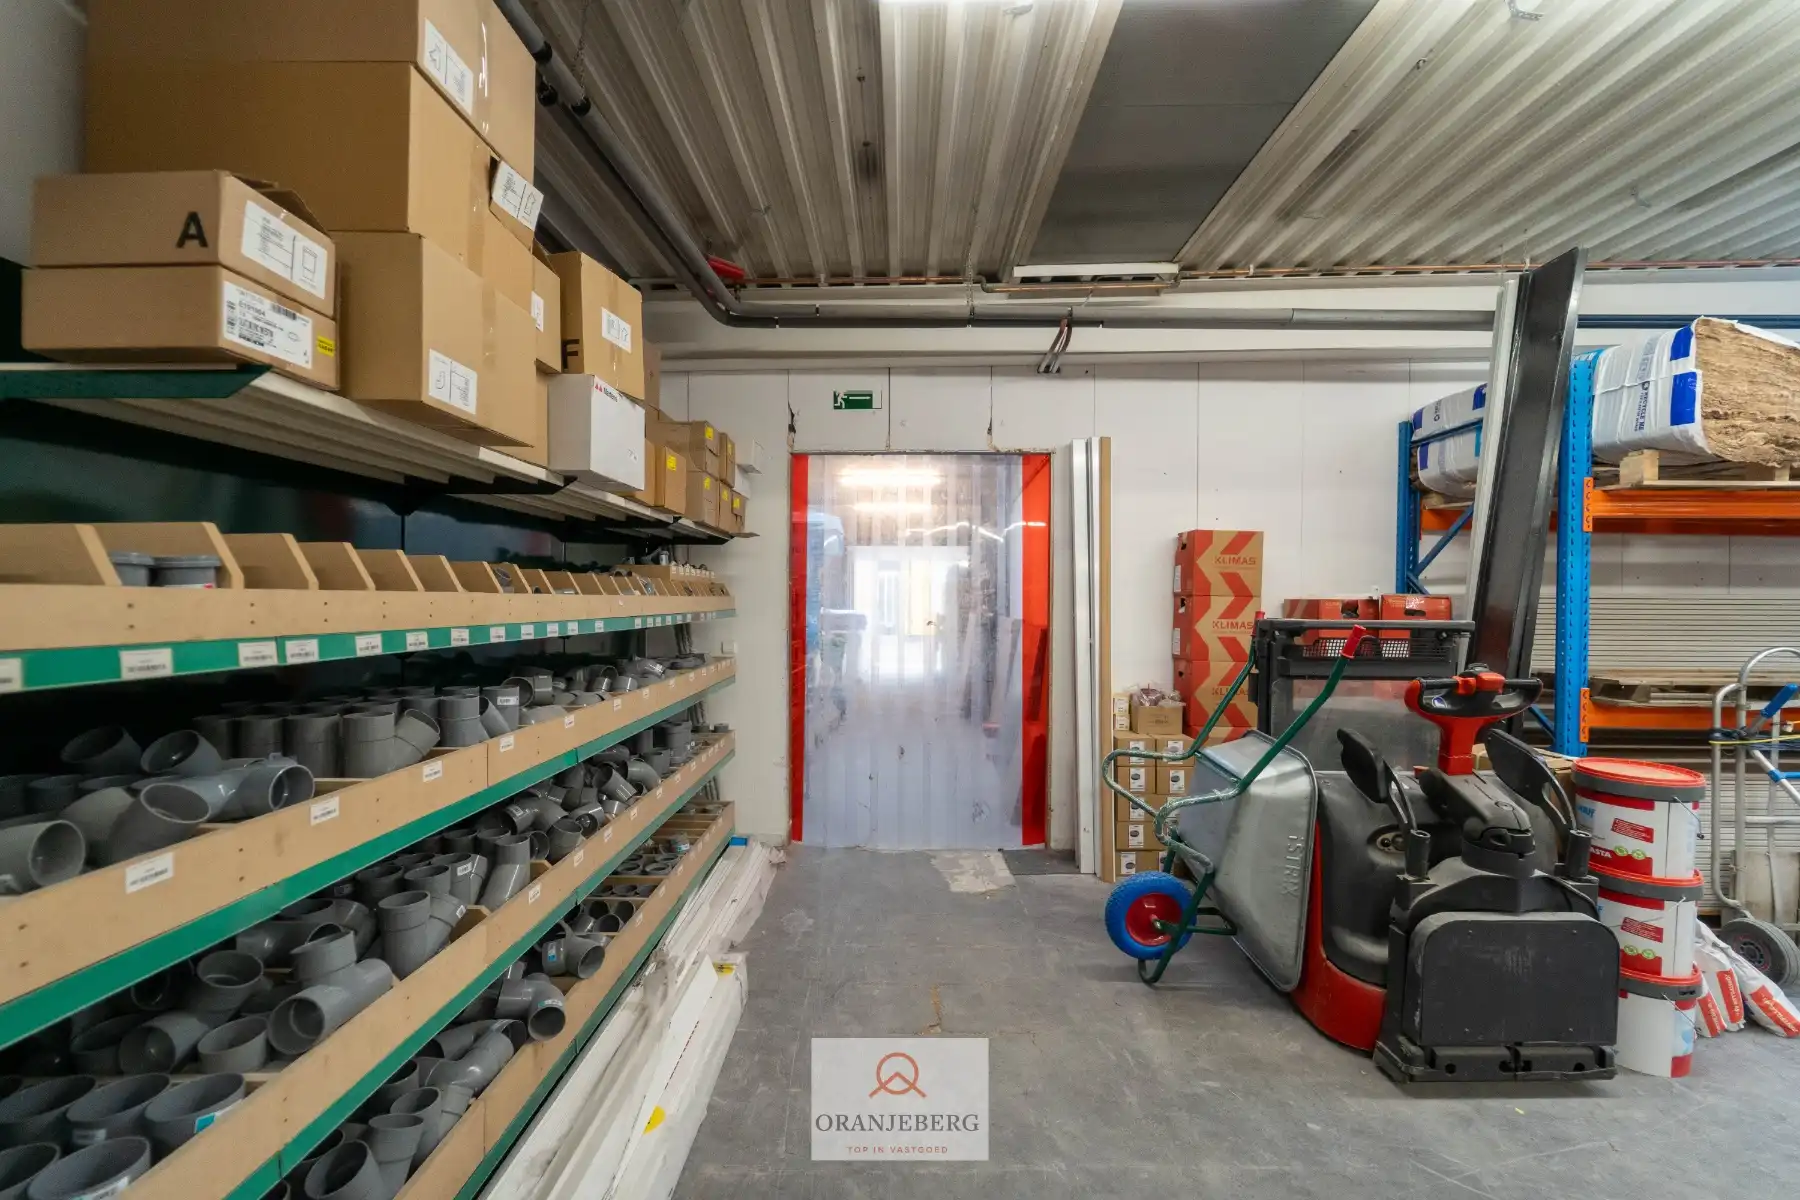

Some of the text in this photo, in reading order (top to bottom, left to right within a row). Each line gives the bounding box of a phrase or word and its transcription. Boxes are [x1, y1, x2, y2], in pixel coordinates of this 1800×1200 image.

[176, 211, 208, 248] A
[1214, 556, 1257, 566] KLIMAS
[1212, 620, 1254, 630] KLIMAS
[1589, 846, 1613, 859] ASTA
